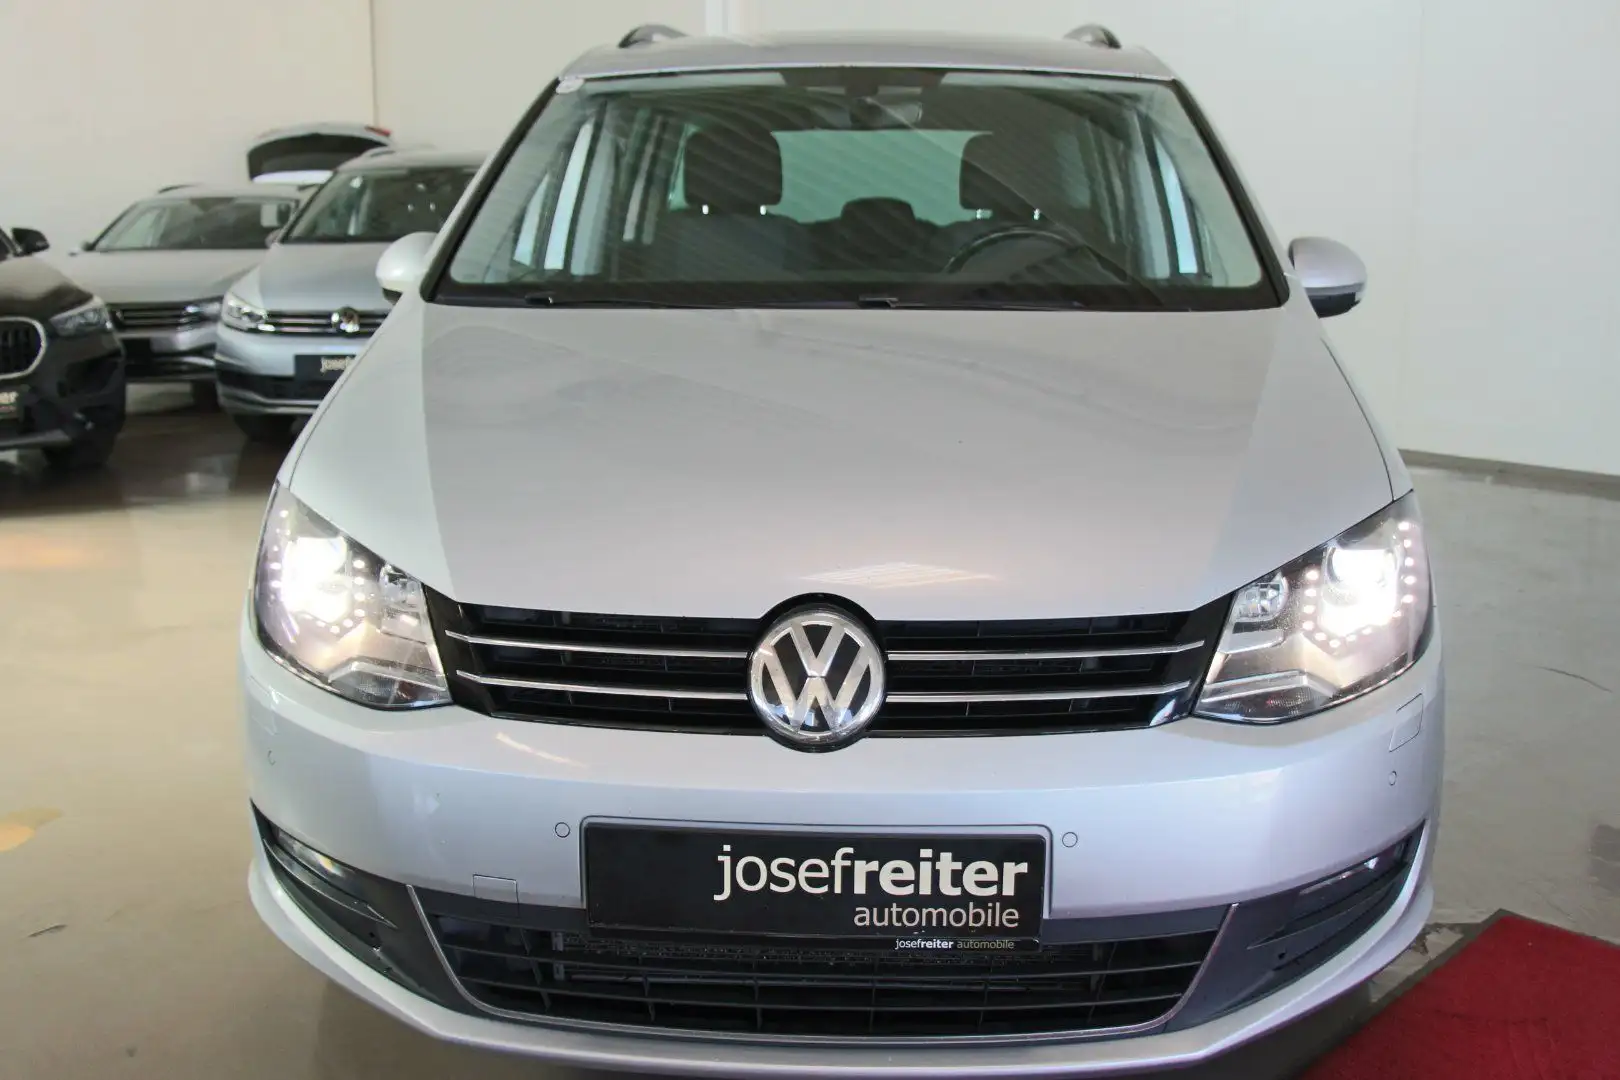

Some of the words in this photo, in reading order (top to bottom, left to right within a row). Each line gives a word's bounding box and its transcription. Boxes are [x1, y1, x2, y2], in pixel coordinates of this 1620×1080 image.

[754, 615, 881, 739] VW
[713, 844, 1028, 901] josefreiter
[853, 902, 1019, 928] automobile
[894, 938, 954, 950] josefreiter
[956, 939, 1015, 949] automobile
